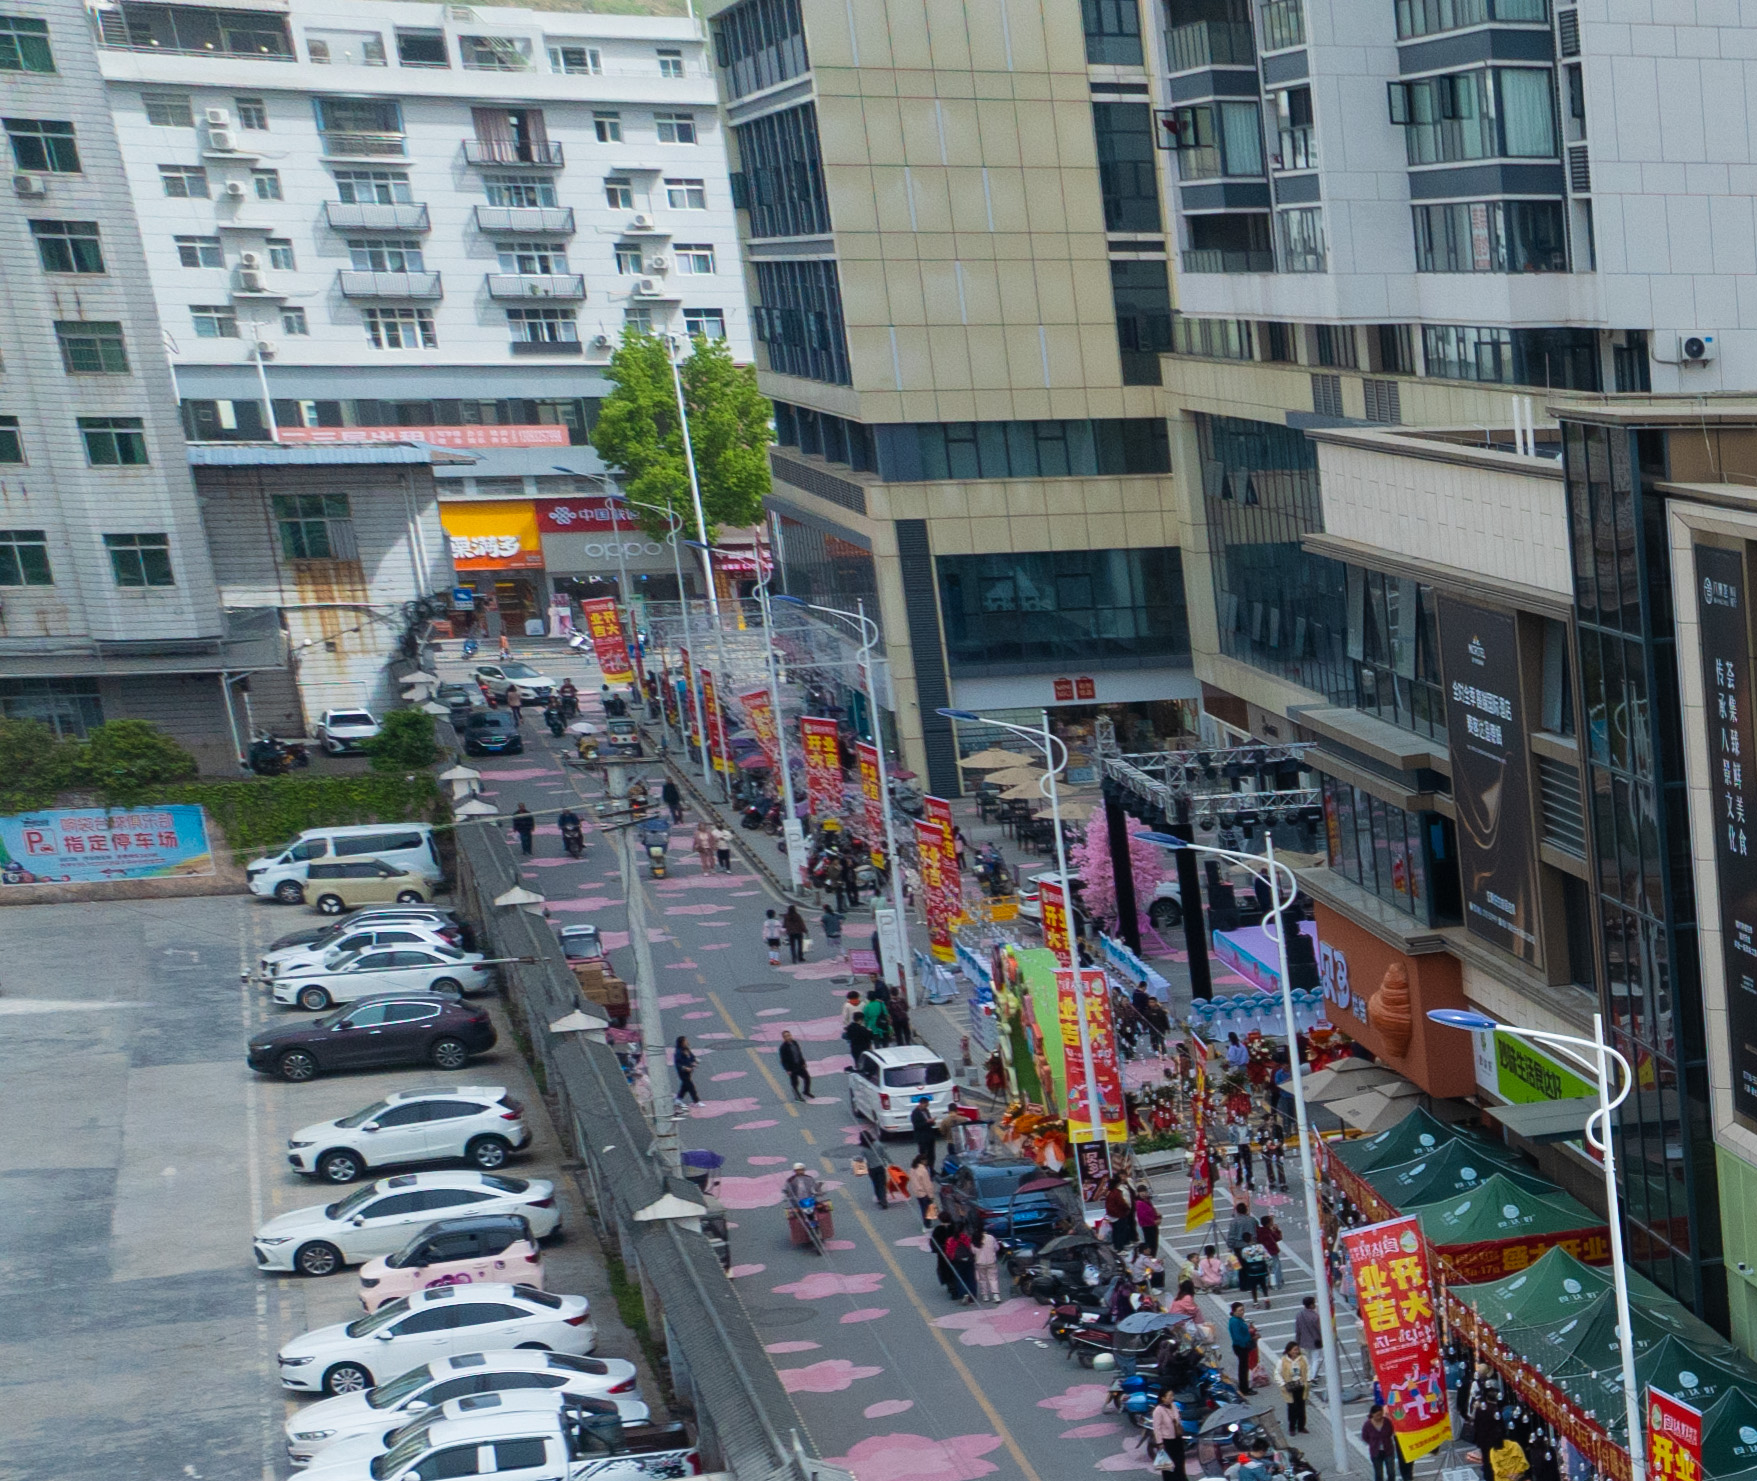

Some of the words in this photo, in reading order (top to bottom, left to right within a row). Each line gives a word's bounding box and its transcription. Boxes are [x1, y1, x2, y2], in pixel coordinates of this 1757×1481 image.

[63, 831, 179, 853] 指定停车场
